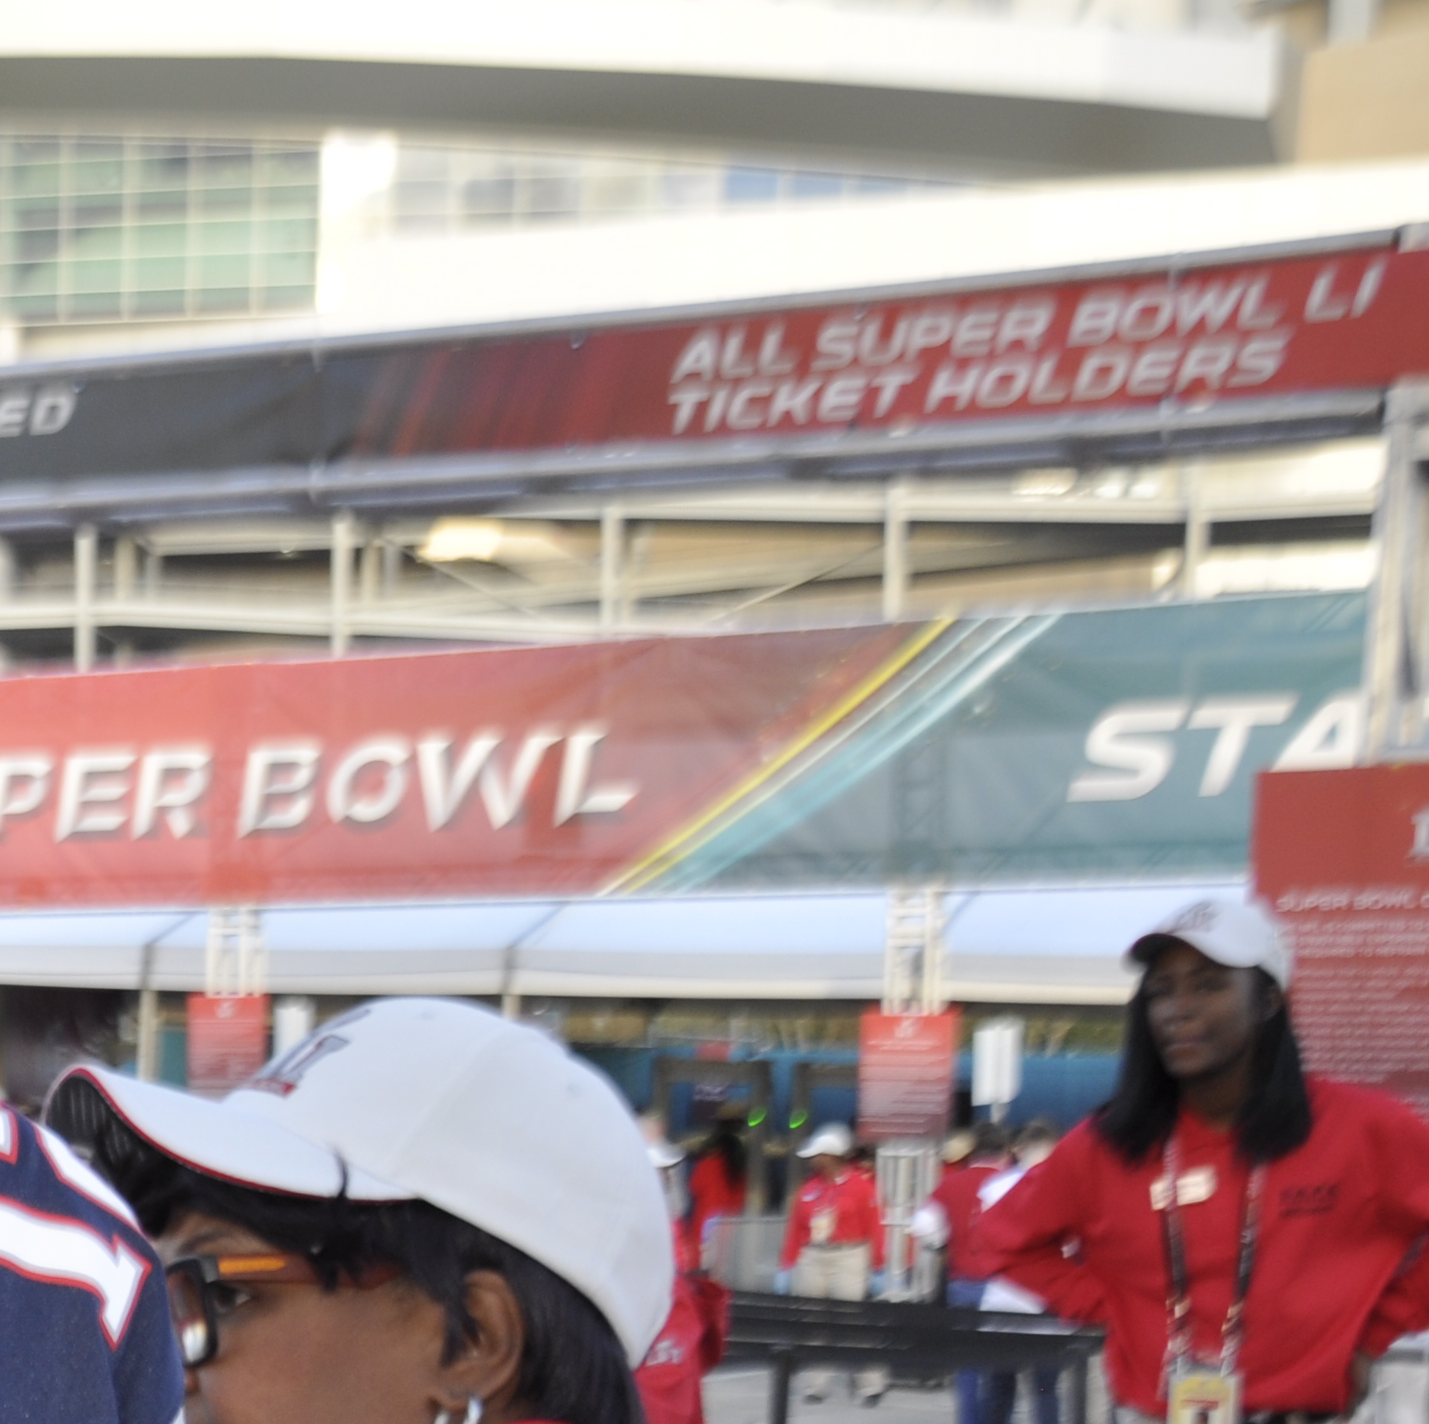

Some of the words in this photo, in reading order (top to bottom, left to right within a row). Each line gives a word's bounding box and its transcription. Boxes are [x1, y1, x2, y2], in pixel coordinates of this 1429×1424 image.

[671, 327, 795, 383] ALL
[810, 293, 1057, 372] SUPER
[1067, 275, 1282, 346] BOWL
[1305, 259, 1387, 322] LI
[669, 366, 919, 434] TICKET
[925, 331, 1293, 413] HOLDERS
[238, 724, 643, 840] BOWL
[1066, 688, 1367, 804] STA
